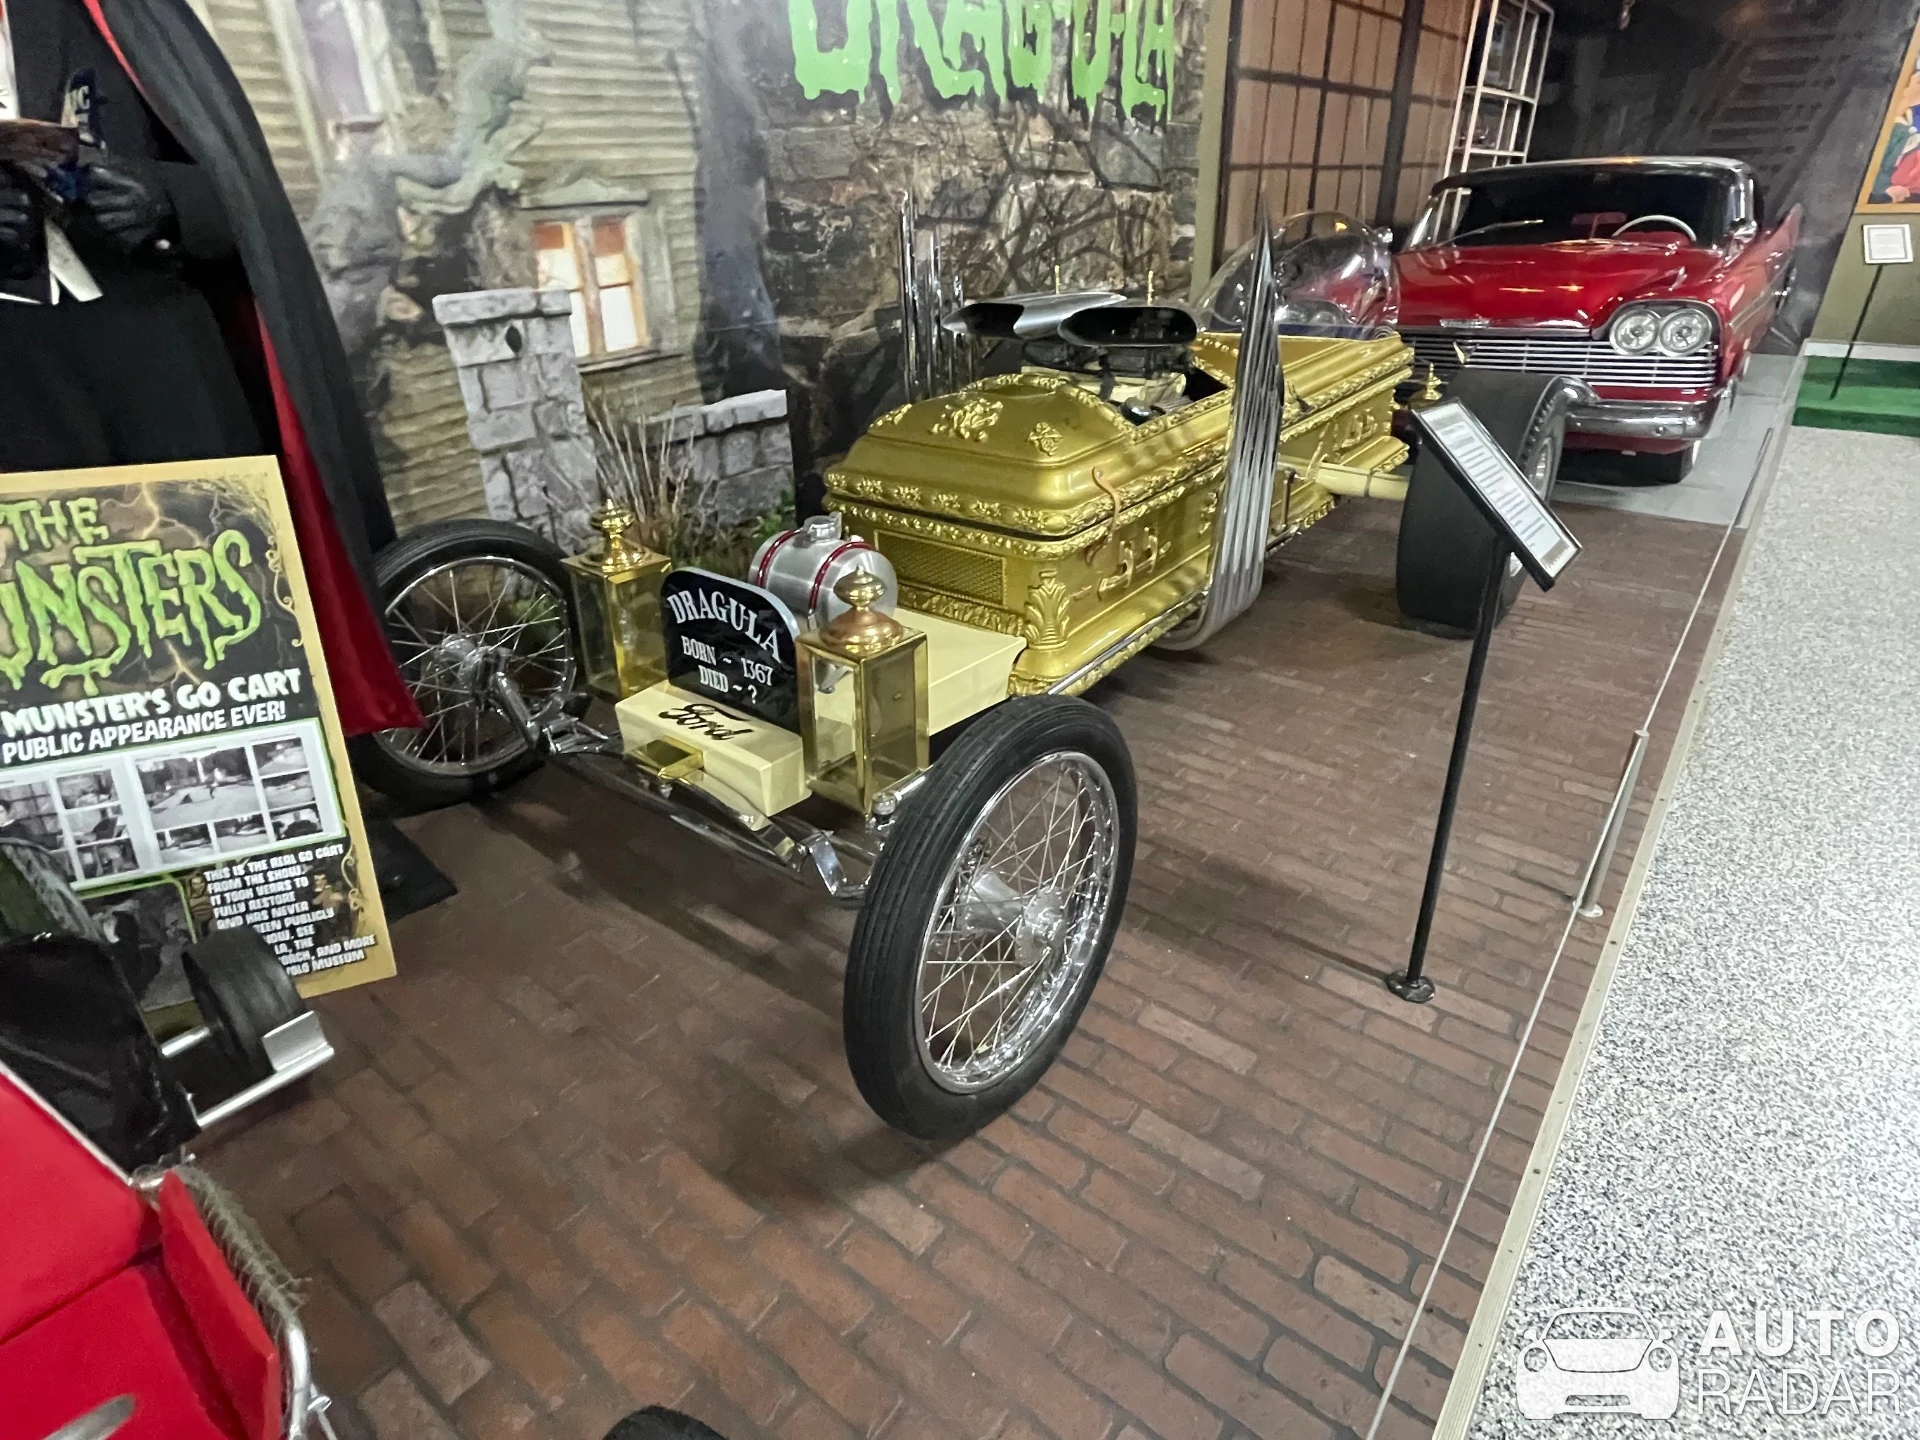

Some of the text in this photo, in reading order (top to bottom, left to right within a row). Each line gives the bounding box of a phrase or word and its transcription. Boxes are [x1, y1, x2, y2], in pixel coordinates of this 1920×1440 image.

[0, 497, 109, 551] THE
[681, 635, 717, 666] BORN
[741, 657, 774, 686] 1367
[698, 665, 729, 692] DIED
[748, 684, 758, 704] ?
[0, 667, 301, 738] MUNSTER'S GO CART
[2, 700, 288, 765] PUBLIC APPEARANCE EVER!
[658, 703, 754, 740] Ford
[203, 843, 344, 881] THIS IS THE REAL GO CART
[207, 877, 243, 894] FROM
[244, 872, 265, 887] THE
[210, 876, 309, 906] IT TOOK YEARS TO
[213, 891, 296, 919] FULLY RESTORE
[216, 901, 310, 930] AND HAS NEVER
[283, 907, 335, 928] PUBLICLY
[294, 937, 315, 950] THE
[316, 942, 342, 958] AND
[343, 934, 376, 951] MORE
[311, 949, 366, 972] MUSEUM
